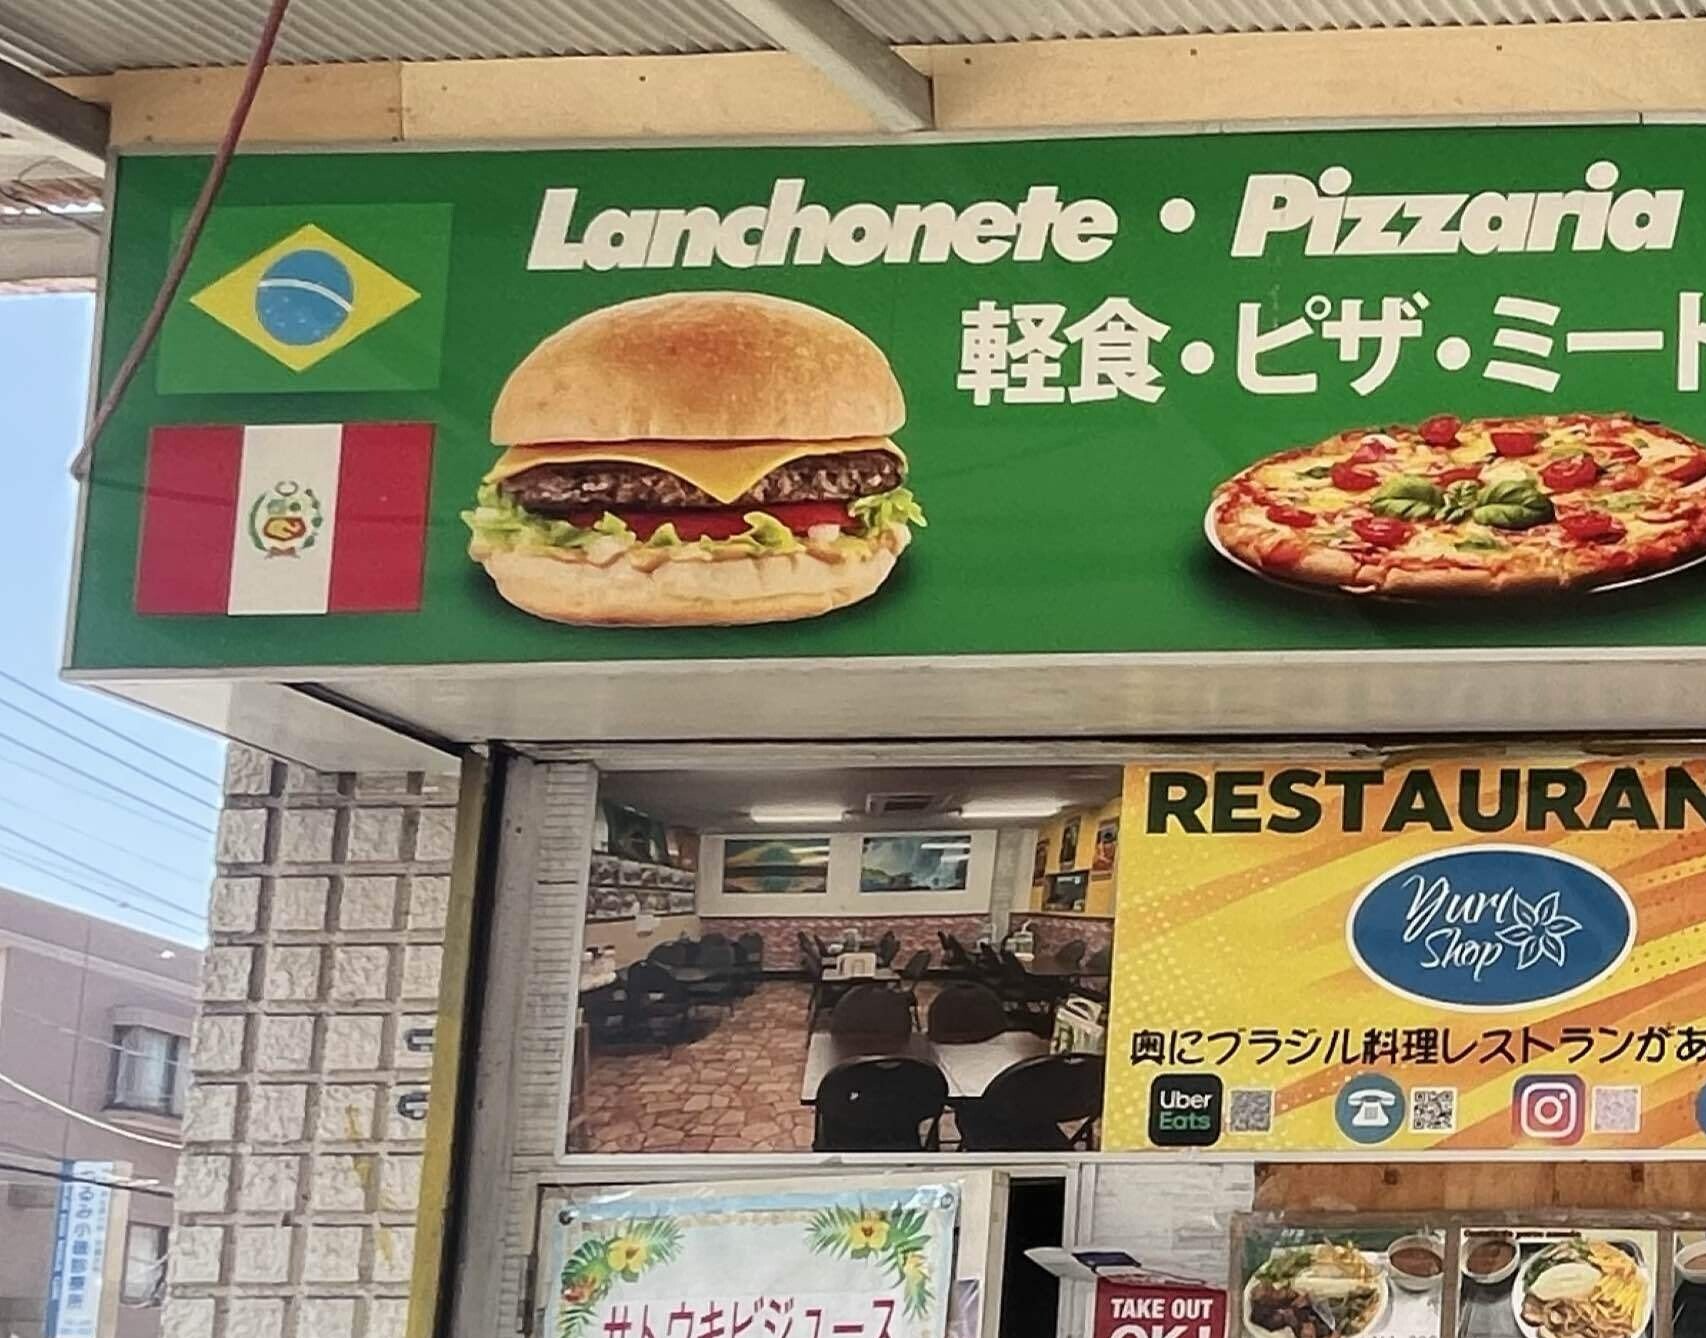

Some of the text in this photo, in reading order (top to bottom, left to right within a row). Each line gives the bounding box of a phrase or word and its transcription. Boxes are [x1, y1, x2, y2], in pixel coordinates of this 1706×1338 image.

[527, 178, 1118, 271] Lanchonete
[1230, 160, 1684, 257] Pizzaria
[1401, 873, 1516, 941] Yuri
[1419, 927, 1505, 982] Shop
[1158, 1089, 1212, 1110] Uber
[1158, 1111, 1212, 1132] Eats
[1111, 1298, 1214, 1319] TAKE OUT
